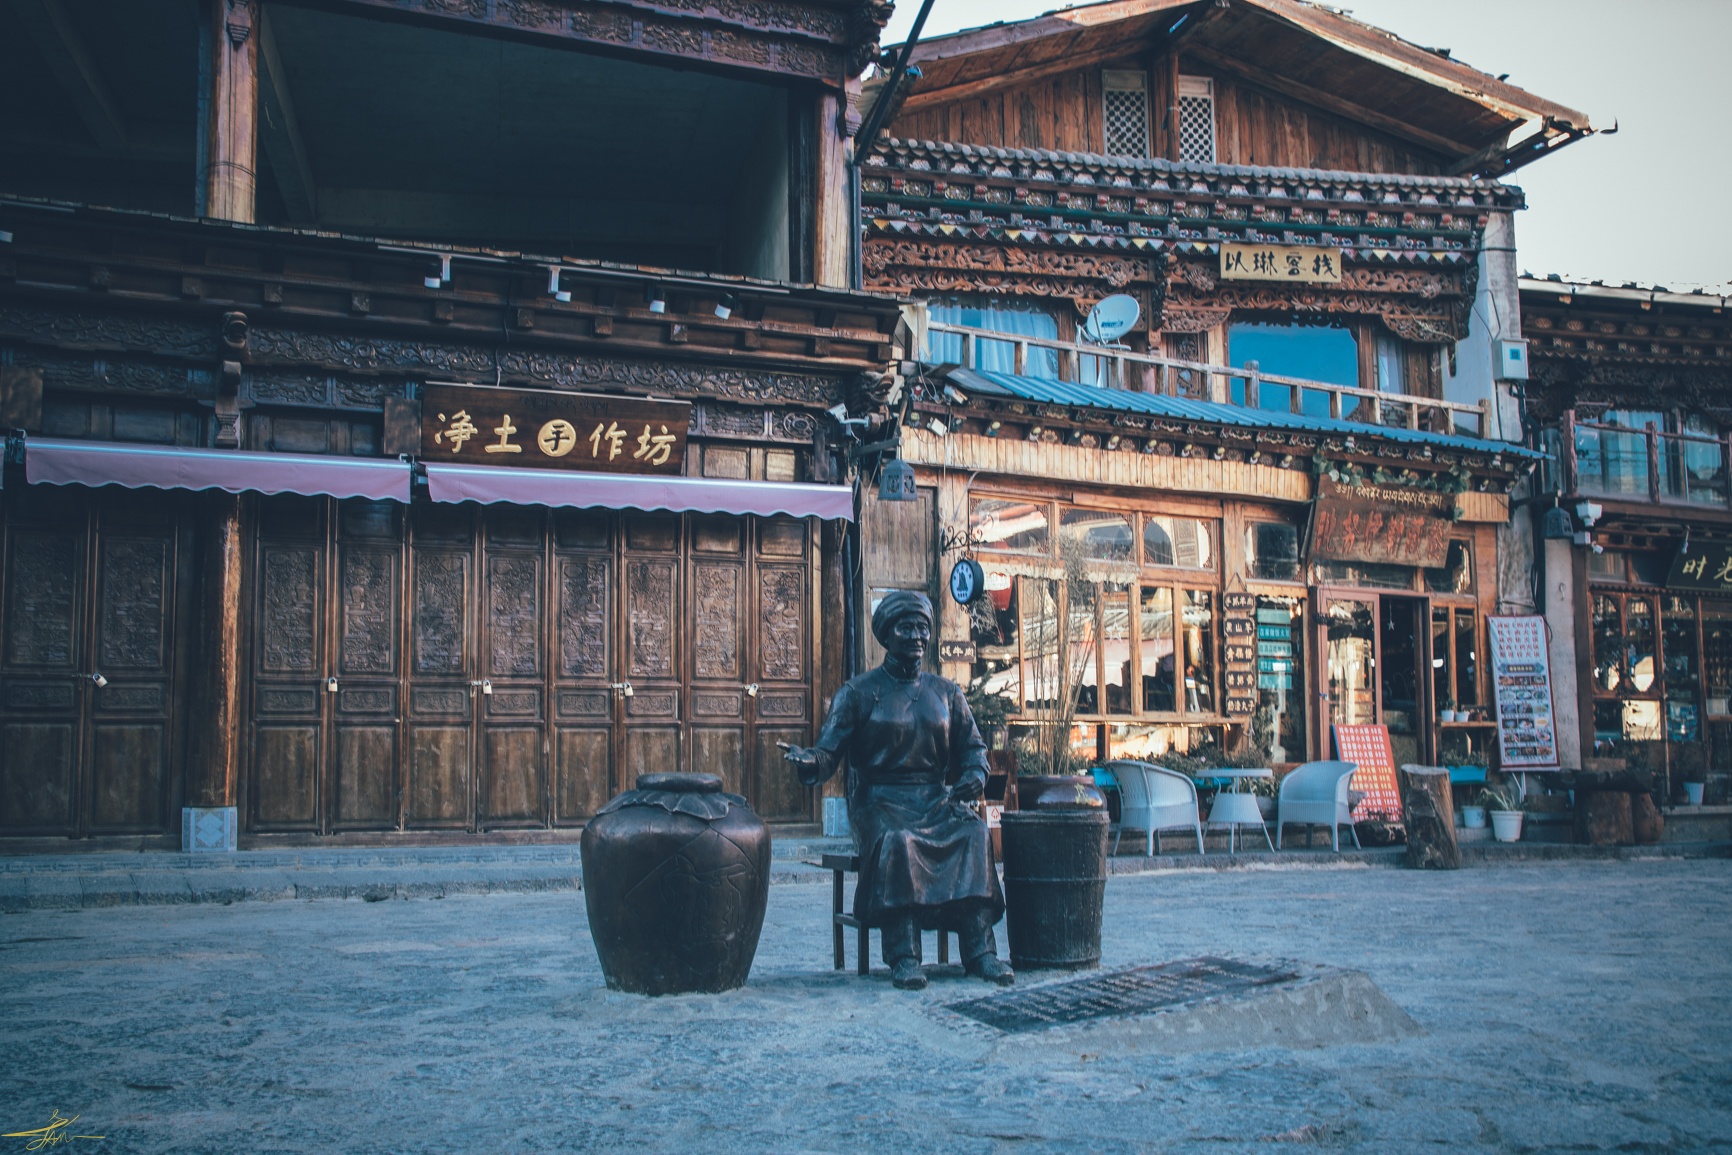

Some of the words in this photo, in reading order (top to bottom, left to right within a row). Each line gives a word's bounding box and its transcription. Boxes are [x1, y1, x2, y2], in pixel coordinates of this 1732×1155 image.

[1225, 250, 1337, 279] 以琳客栈
[434, 409, 677, 466] 净土手作坊
[941, 644, 975, 658] 牦牛肉
